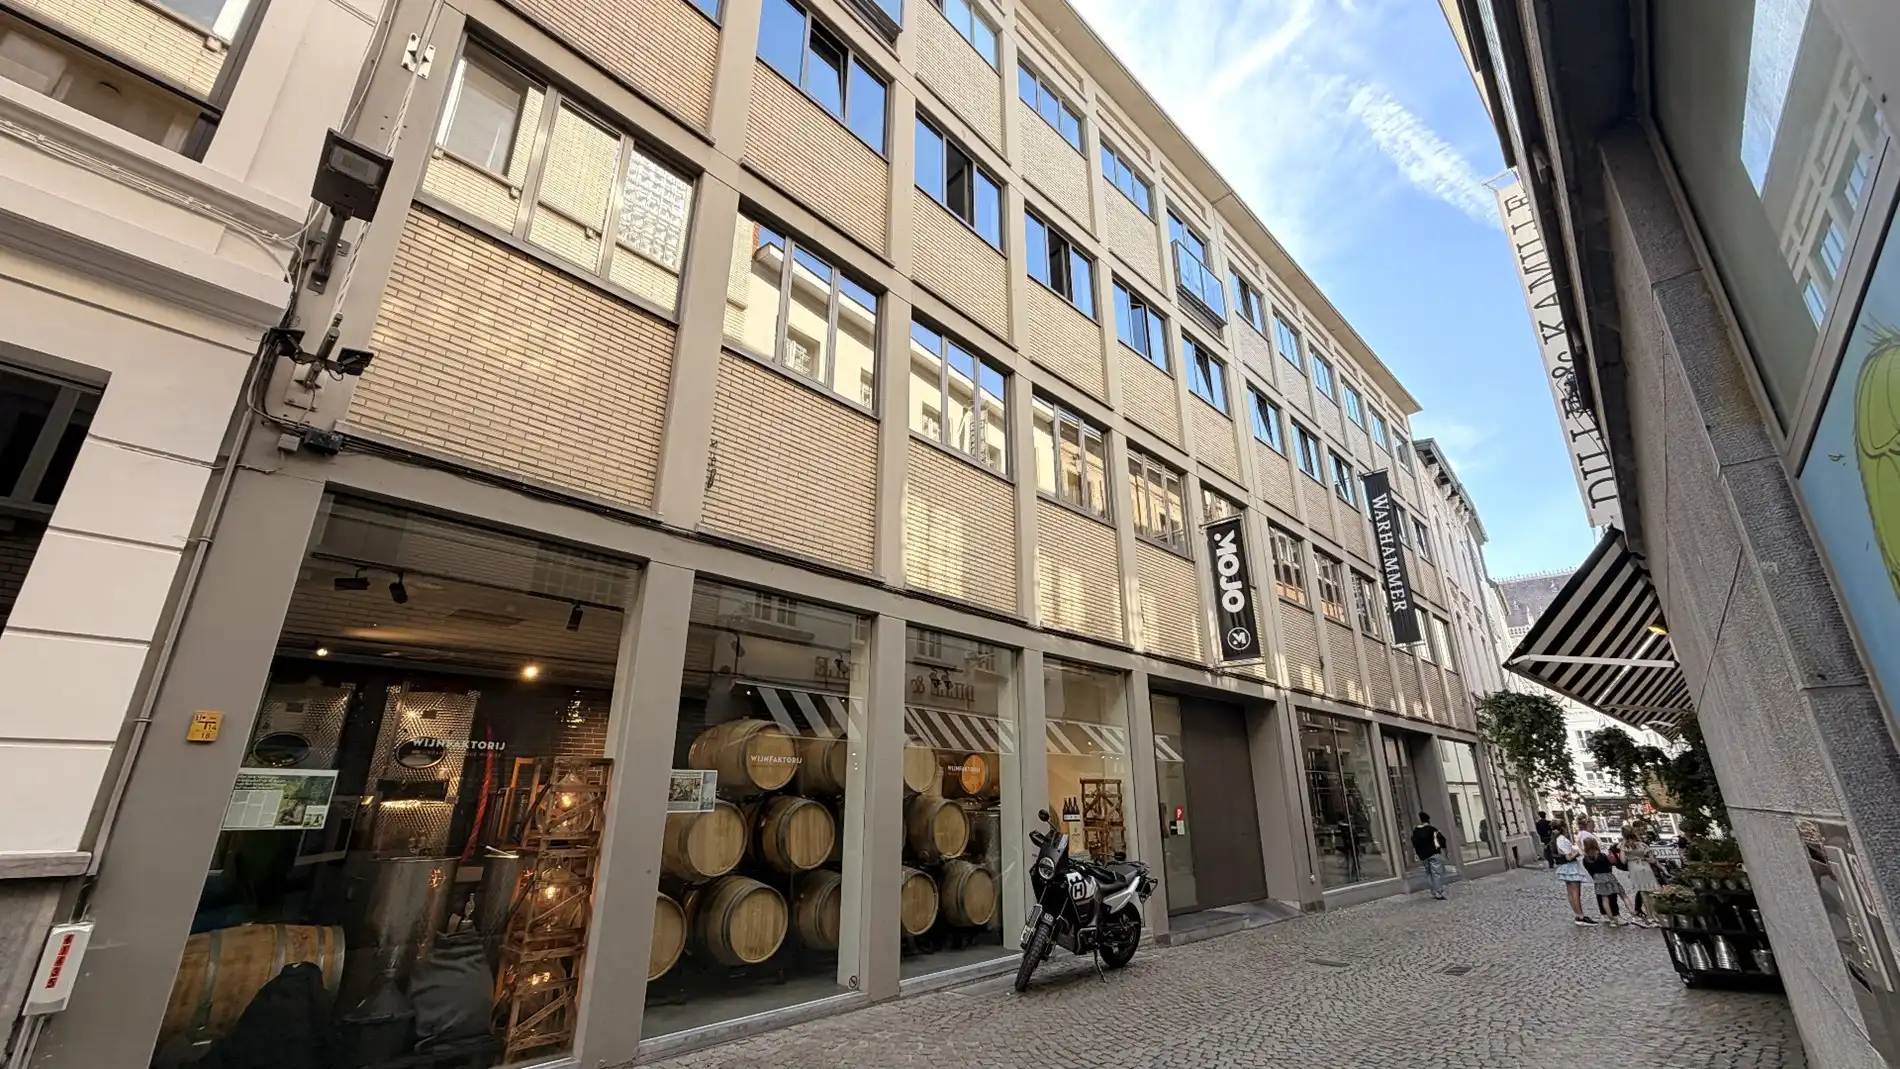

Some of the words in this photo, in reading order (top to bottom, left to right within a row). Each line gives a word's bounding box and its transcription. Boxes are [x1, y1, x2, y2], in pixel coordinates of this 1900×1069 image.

[1214, 529, 1245, 613] MOJO
[1372, 493, 1407, 612] WARHAMMER
[412, 738, 506, 751] WIJNFAKTORIJ
[751, 755, 803, 764] WIJNFAKTORIJ
